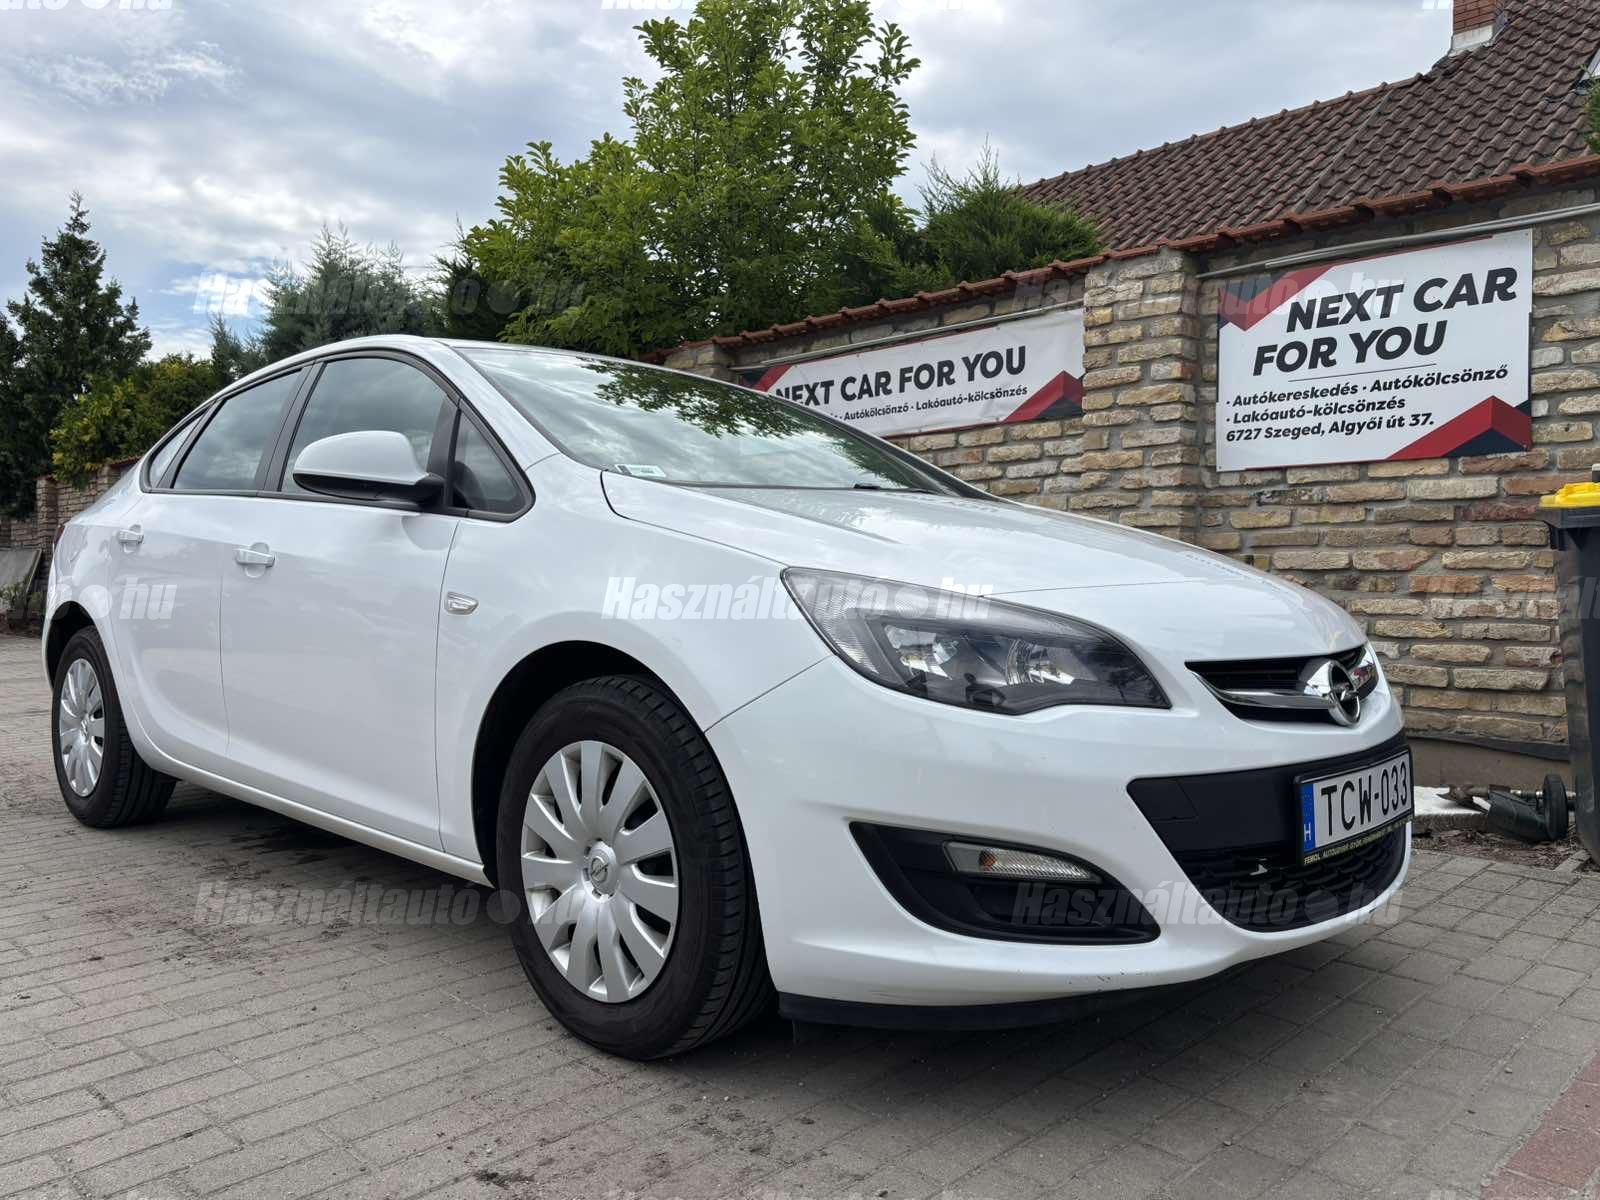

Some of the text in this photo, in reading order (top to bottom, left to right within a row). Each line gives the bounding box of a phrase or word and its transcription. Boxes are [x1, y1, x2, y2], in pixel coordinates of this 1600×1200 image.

[1286, 267, 1518, 333] NEXT CAR
[840, 371, 893, 402] CAR
[899, 359, 956, 393] FOR
[962, 345, 1026, 382] YOU
[1253, 320, 1448, 377] FOR YOU
[1232, 364, 1508, 407] Autókereskedés Autókölcsönző
[1233, 396, 1406, 424] Lakóautó-kölcsönzés
[1226, 413, 1434, 442] 6727 Szeged, Algyői út 37.
[1303, 823, 1313, 842] H
[1321, 761, 1408, 837] TCW-033
